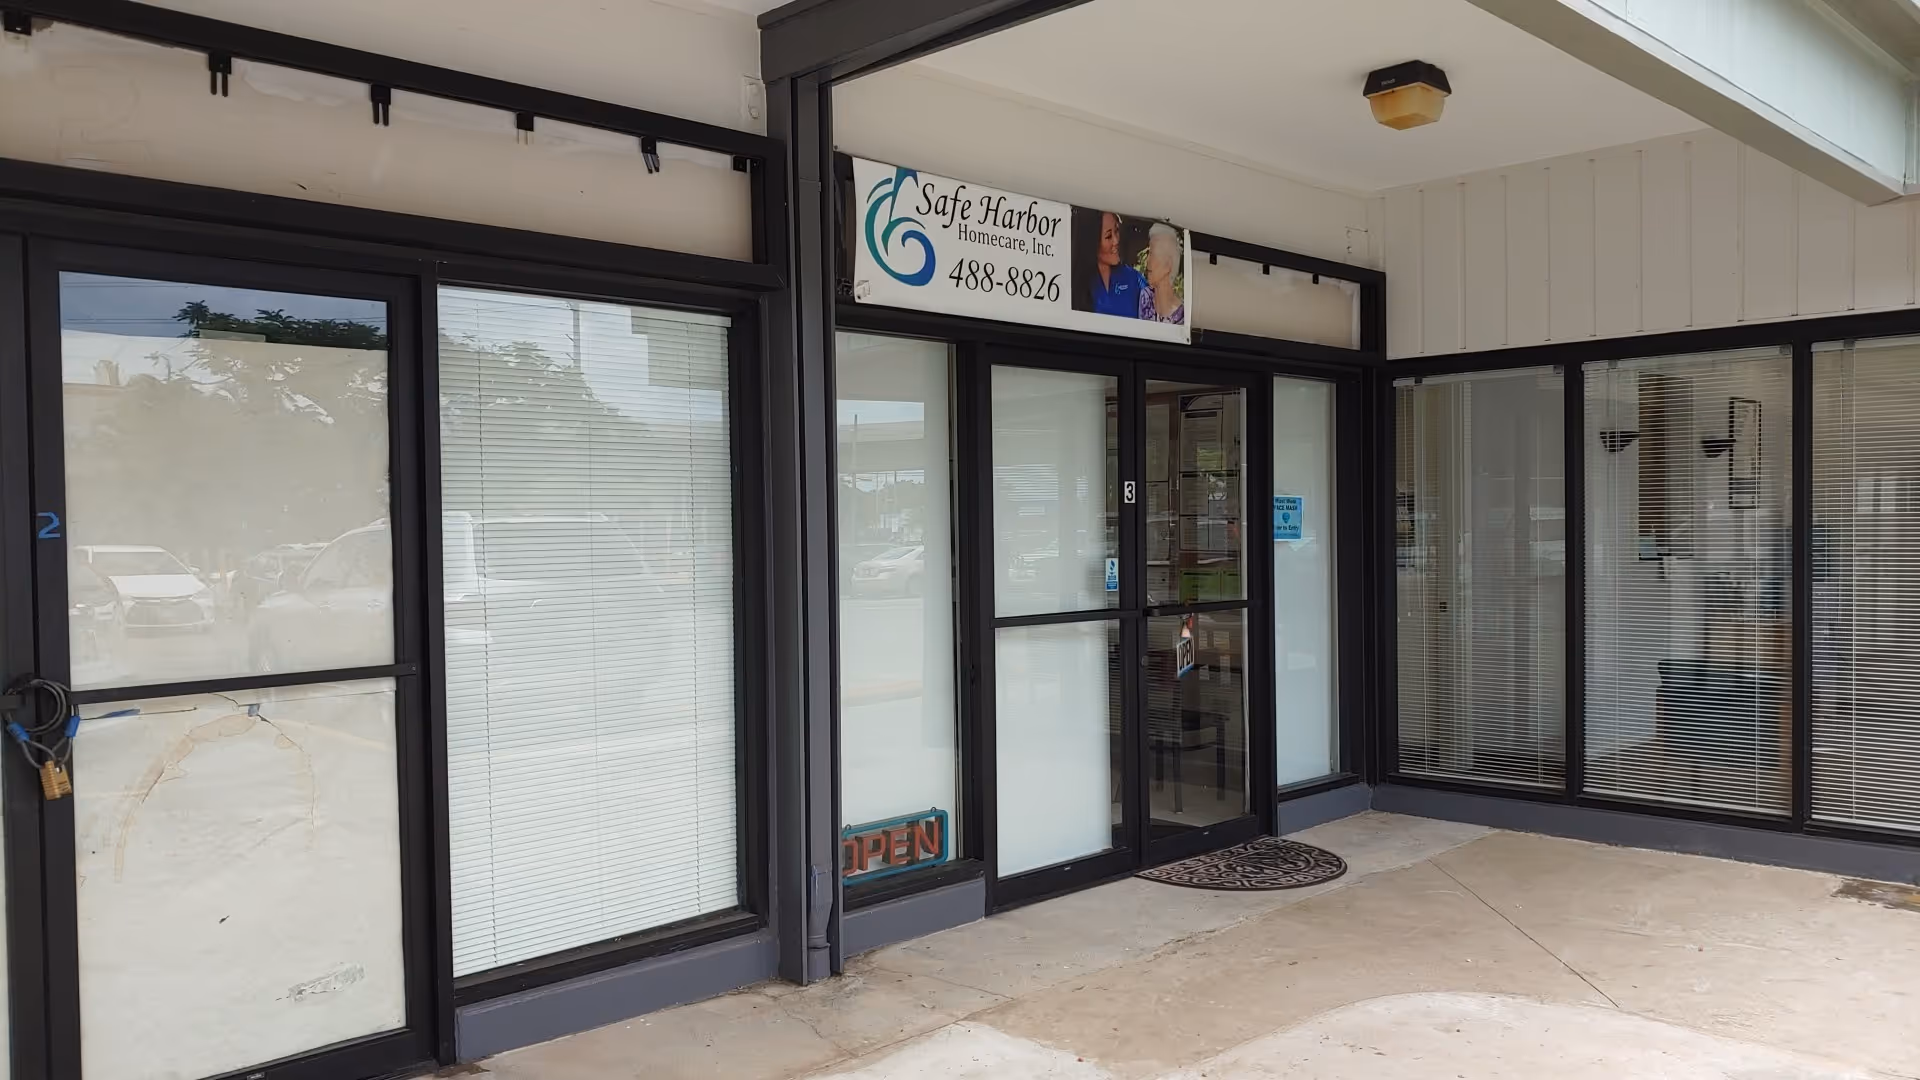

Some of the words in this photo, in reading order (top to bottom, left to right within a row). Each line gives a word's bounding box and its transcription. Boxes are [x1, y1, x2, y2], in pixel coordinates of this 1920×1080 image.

[915, 182, 972, 229] Safe
[977, 195, 1062, 238] Harbor
[957, 222, 1029, 255] Homecare,
[1032, 237, 1055, 257] Inc.
[948, 257, 1063, 303] 488-8826
[1125, 482, 1135, 502] 3
[37, 511, 61, 539] 2
